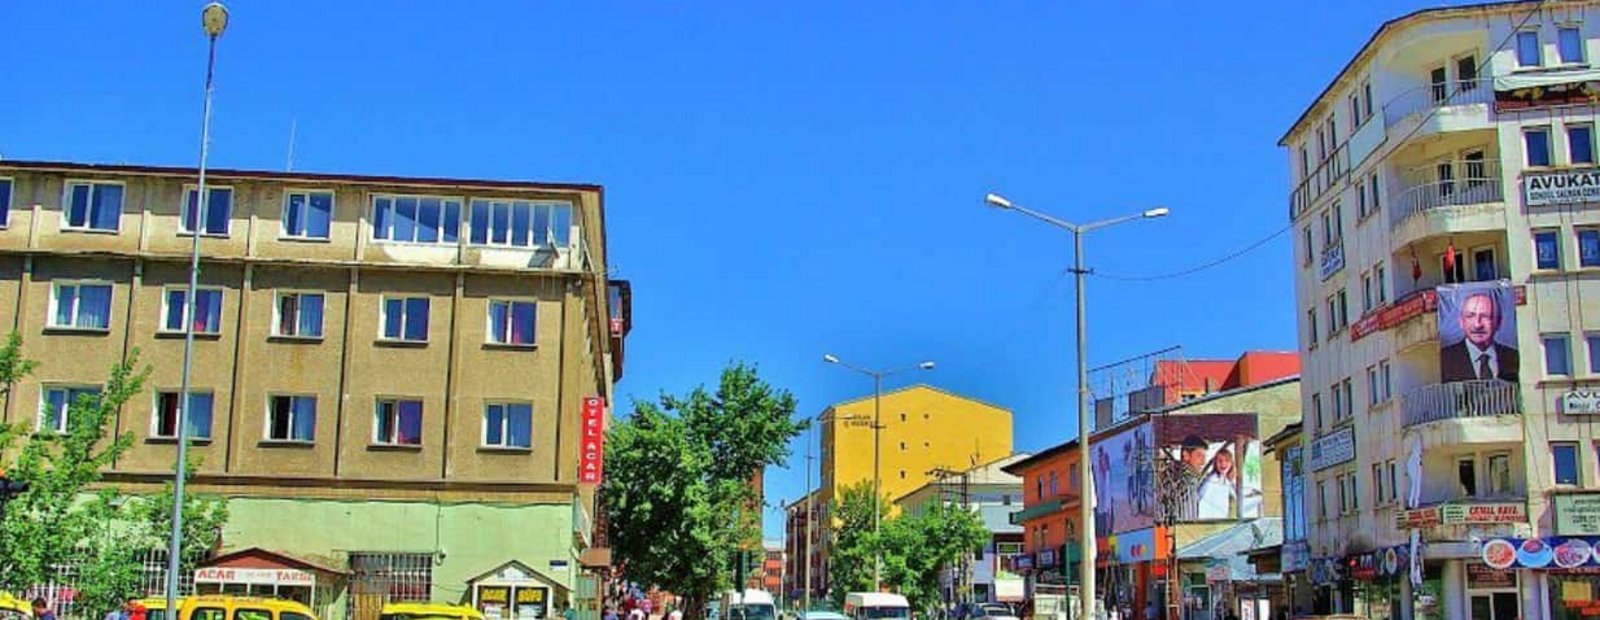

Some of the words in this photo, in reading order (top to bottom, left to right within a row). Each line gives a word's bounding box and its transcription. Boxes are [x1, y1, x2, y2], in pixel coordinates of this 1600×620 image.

[1531, 174, 1600, 189] AVUKAT
[588, 399, 598, 436] OTEL
[586, 442, 597, 480] ACAR
